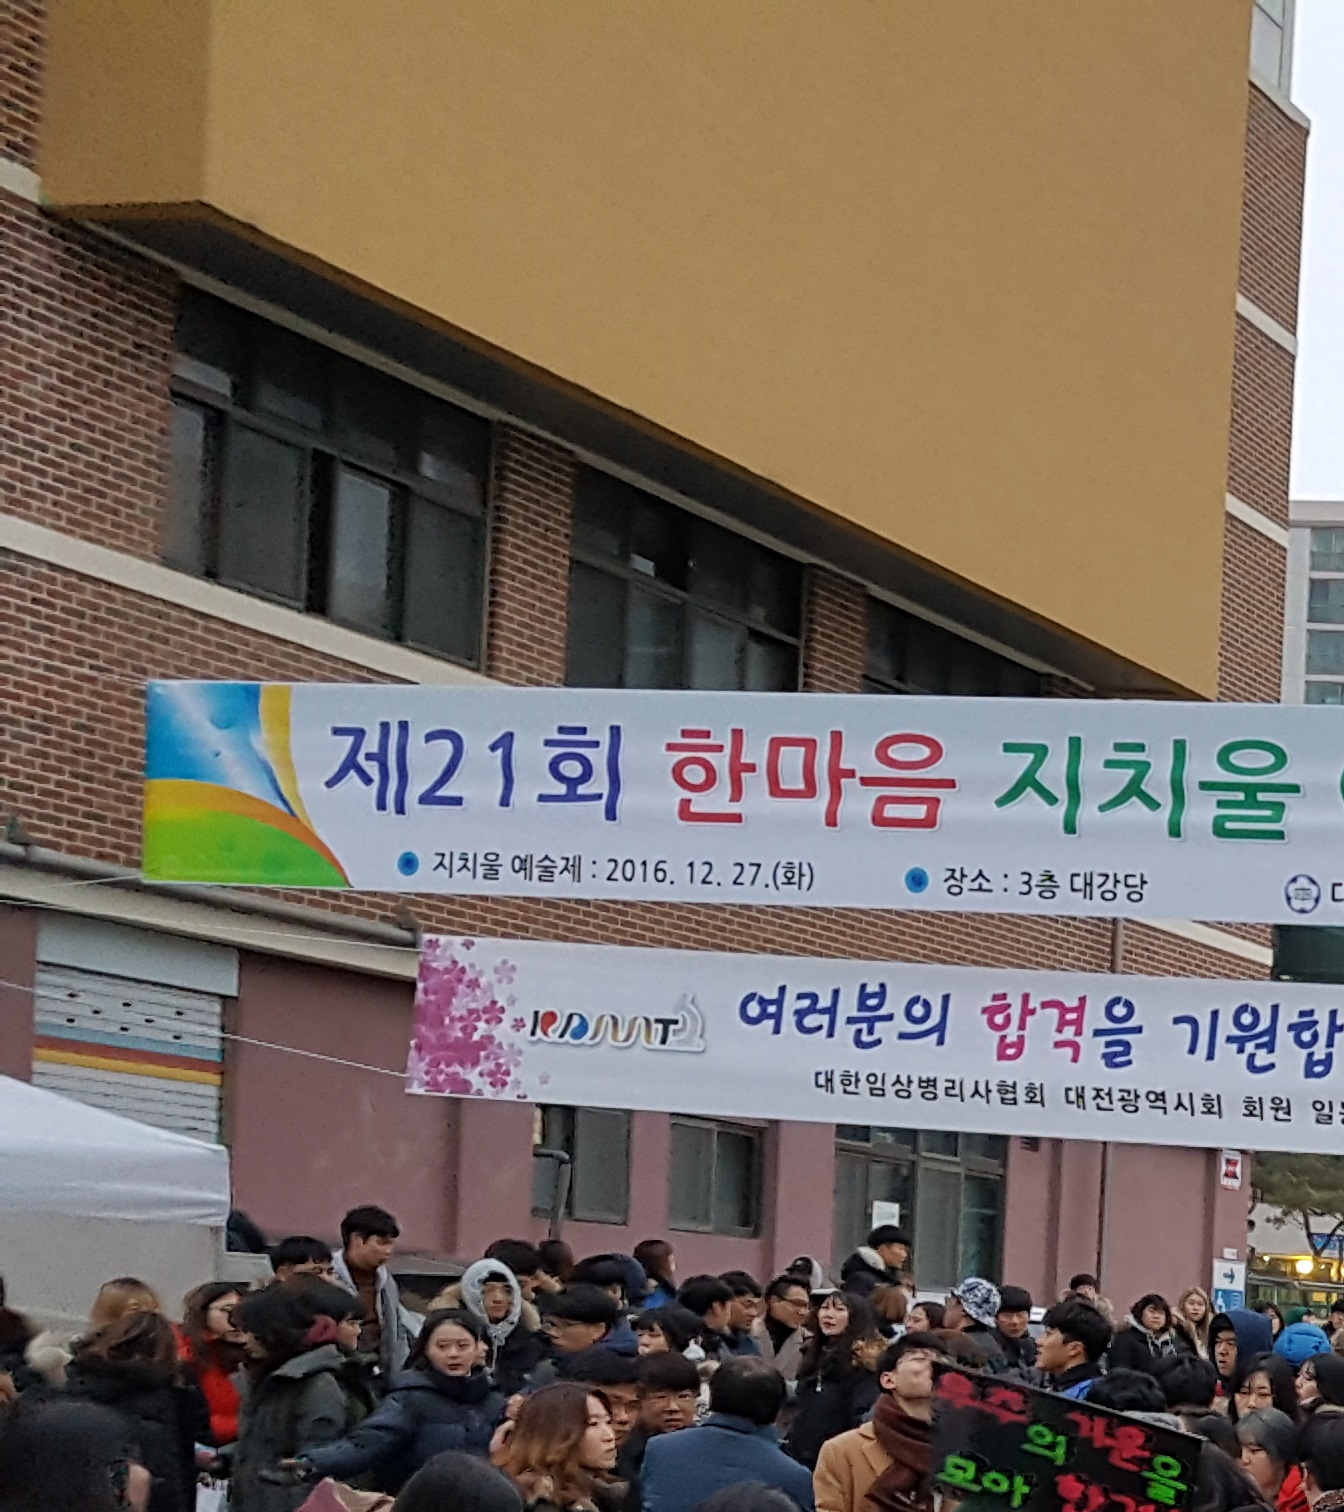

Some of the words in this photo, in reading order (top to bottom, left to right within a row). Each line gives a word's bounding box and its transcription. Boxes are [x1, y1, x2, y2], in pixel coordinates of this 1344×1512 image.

[323, 719, 622, 823] 제21회
[665, 727, 958, 830] 한마음
[994, 734, 1302, 843] 지치울
[432, 851, 503, 881] 지치울
[511, 853, 582, 884] 예술제
[943, 867, 993, 897] 장소
[1018, 870, 1060, 899] 3층
[1070, 871, 1148, 903] 대강당
[738, 984, 951, 1050] 여러분의
[980, 992, 1144, 1069] 합격을
[813, 1069, 1046, 1109] 대한임상병리사협회
[1064, 1086, 1223, 1120] 대전광역시회
[1242, 1095, 1292, 1124] 회원
[936, 1453, 1031, 1509] 모아
